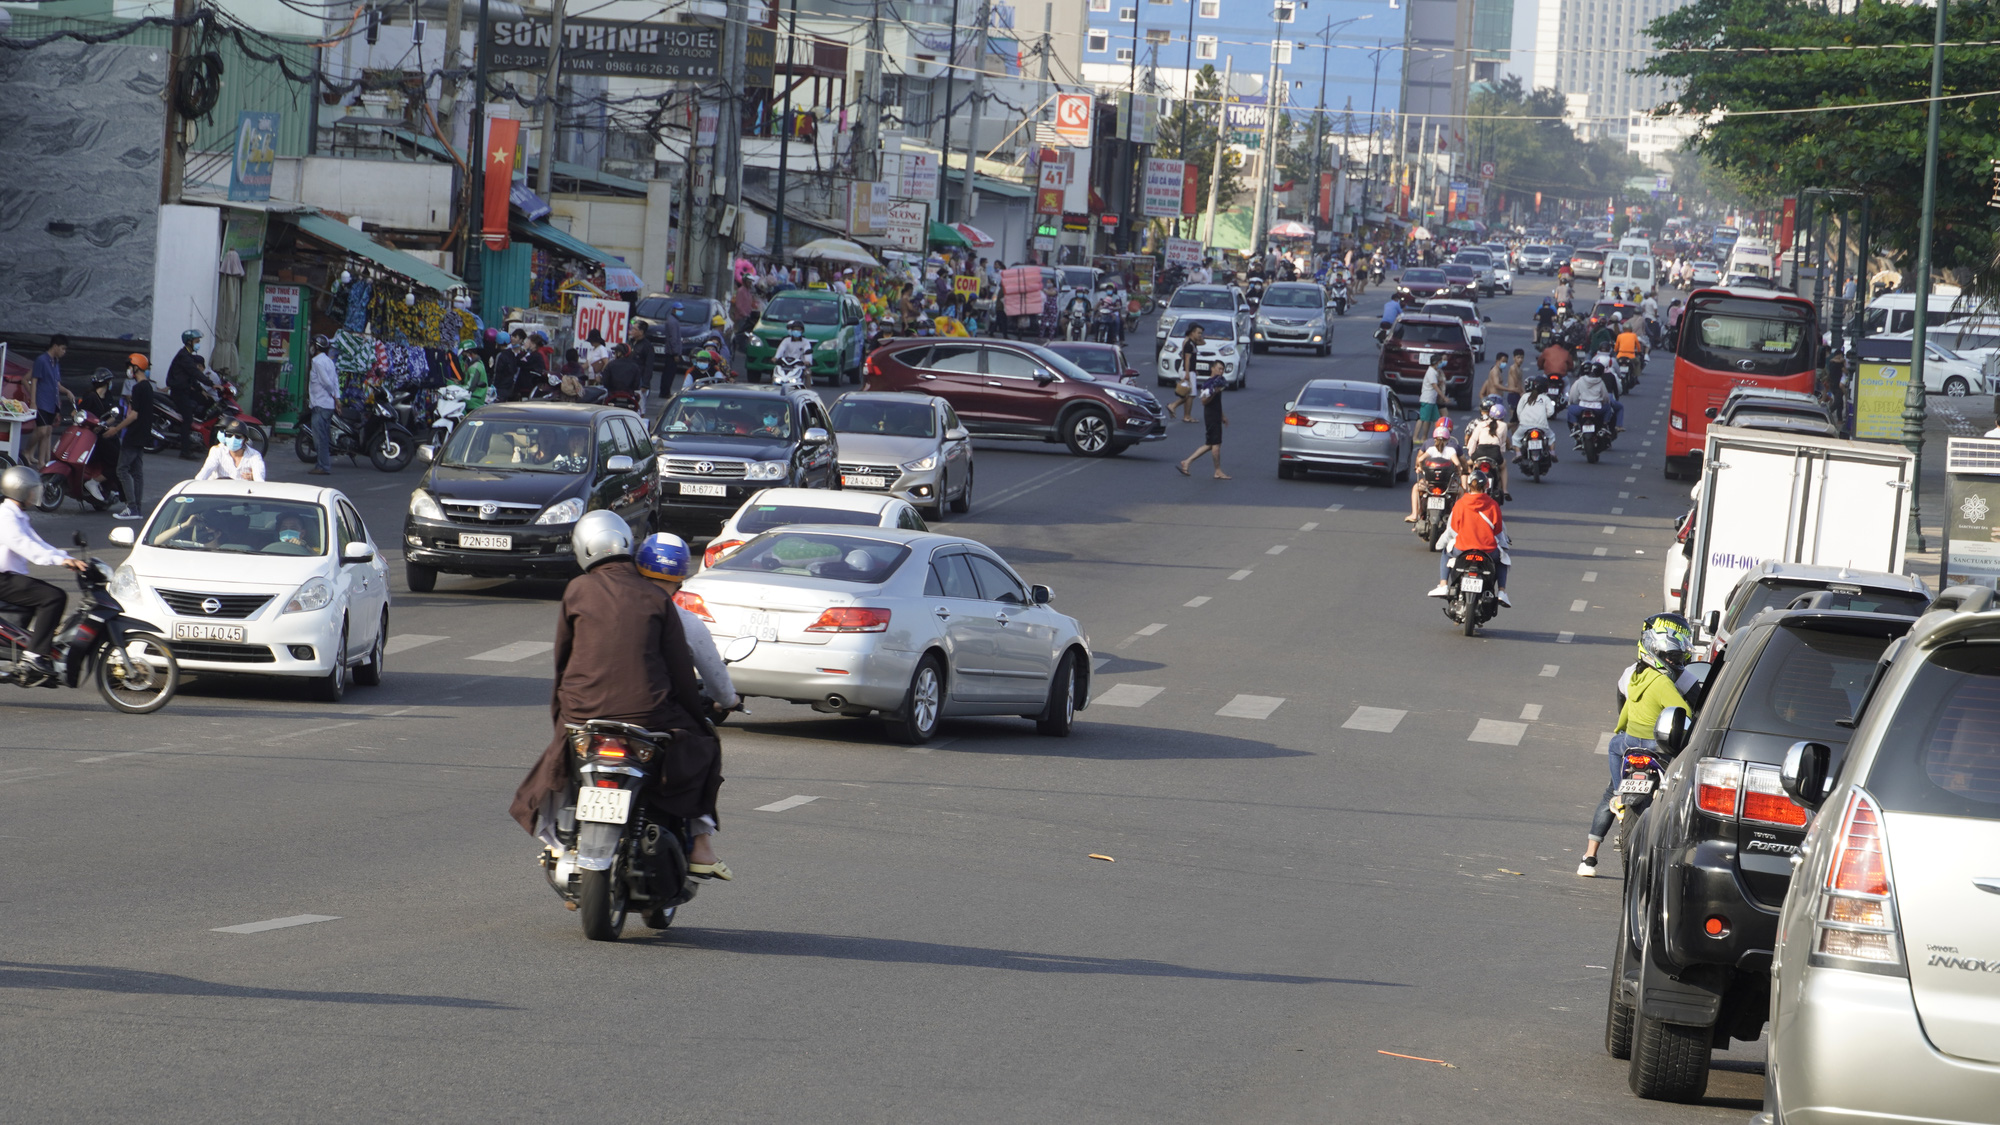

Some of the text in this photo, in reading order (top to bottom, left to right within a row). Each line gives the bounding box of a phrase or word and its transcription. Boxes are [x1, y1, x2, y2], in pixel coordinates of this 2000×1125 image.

[664, 31, 717, 48] HOTEL
[668, 48, 712, 58] 26 FLOOR
[605, 61, 632, 73] 0986
[634, 63, 647, 73] 46
[650, 64, 663, 74] 26
[665, 65, 679, 75] 26
[1044, 171, 1063, 184] 41
[605, 311, 626, 344] XE
[681, 484, 725, 496] 60A-677.41
[463, 536, 508, 548] 72N-3158
[1953, 556, 1993, 565] SANCTUARY
[178, 624, 241, 641] 51G-140.45
[1753, 831, 1777, 840] TOYOTA
[1926, 943, 1959, 954] TOYOTA
